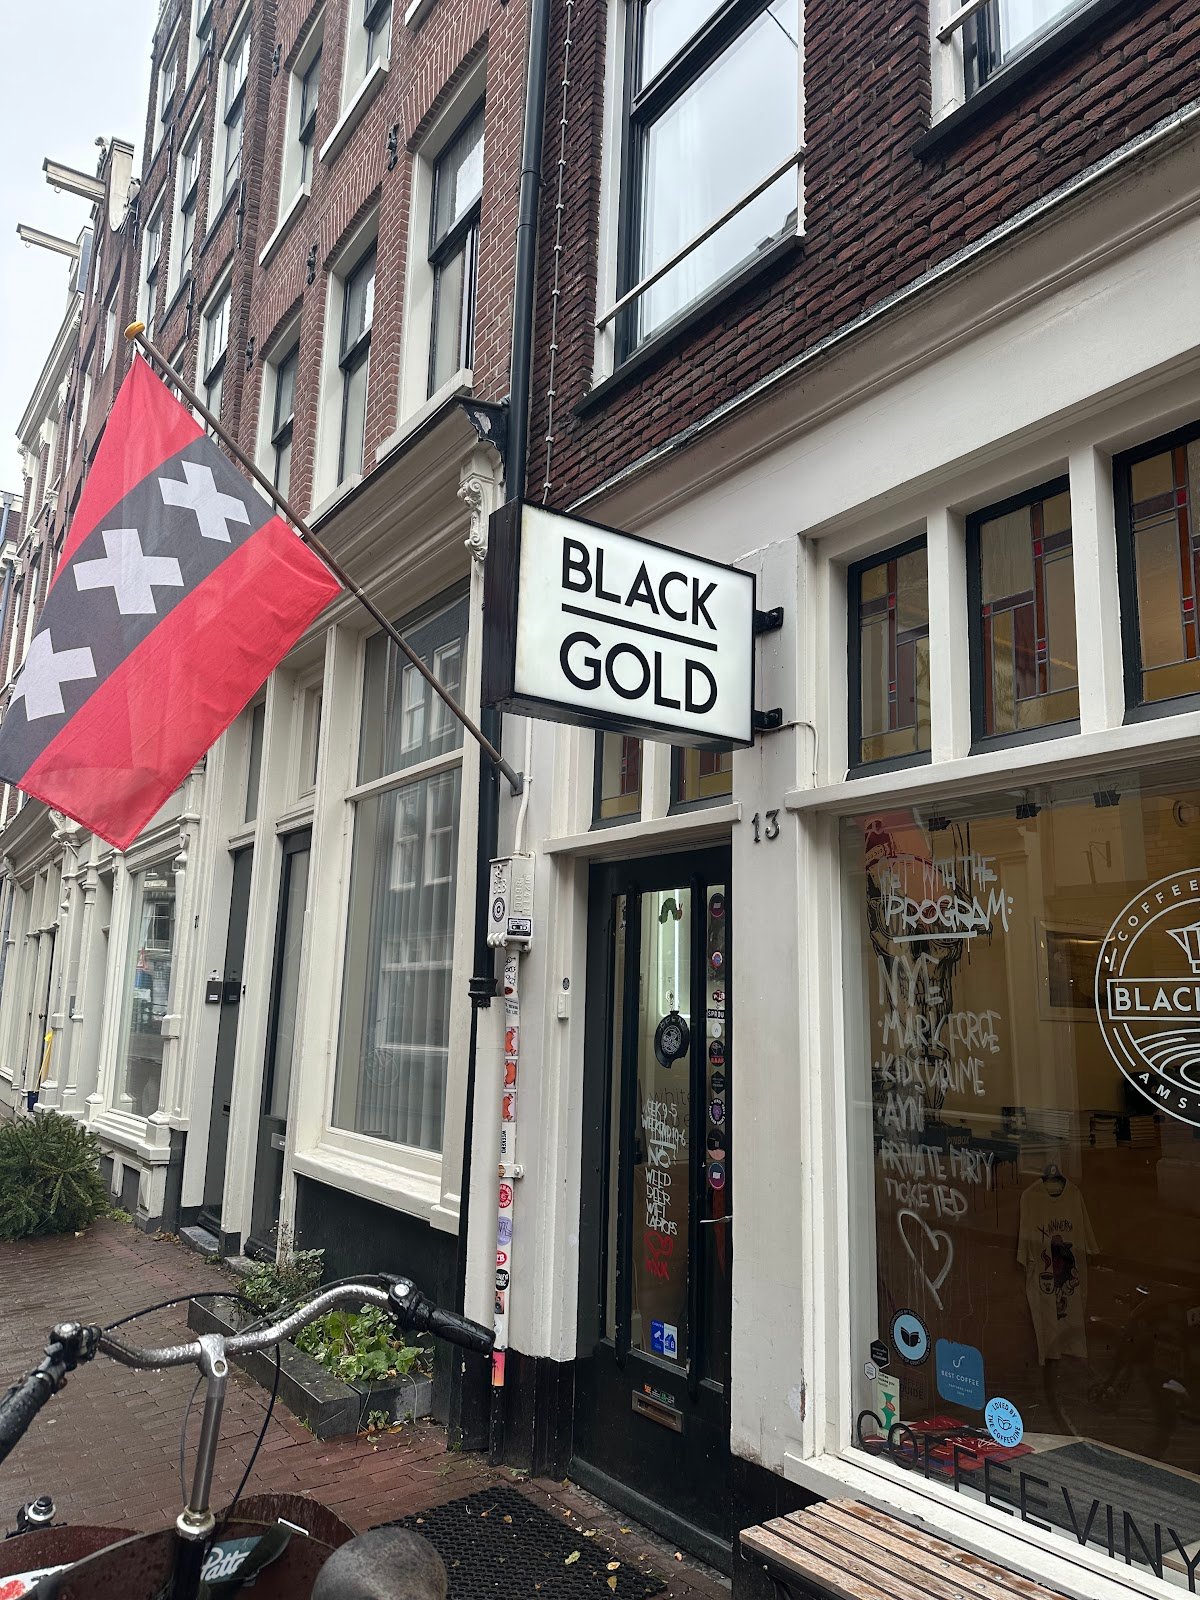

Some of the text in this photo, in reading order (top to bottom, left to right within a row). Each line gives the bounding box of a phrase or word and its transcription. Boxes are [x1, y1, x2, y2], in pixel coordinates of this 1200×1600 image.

[561, 536, 719, 632] BLACK
[559, 631, 719, 715] GOLD
[751, 808, 781, 843] 13
[921, 857, 957, 891] WITH
[957, 852, 998, 891] THE
[884, 888, 1015, 933] PROGRAM:
[1117, 879, 1199, 942] COFFEE
[877, 952, 944, 1008] NYE
[1114, 986, 1200, 1012] BLAC
[1138, 1072, 1200, 1109] AMS
[645, 1166, 672, 1190] WEED
[646, 1184, 672, 1206] BEER
[645, 1211, 678, 1236] LAPTOPS
[940, 1369, 980, 1388] BEST COFFEE
[991, 1400, 1017, 1418] LOVED BY
[987, 1413, 1021, 1445] THE COFFEEVINE
